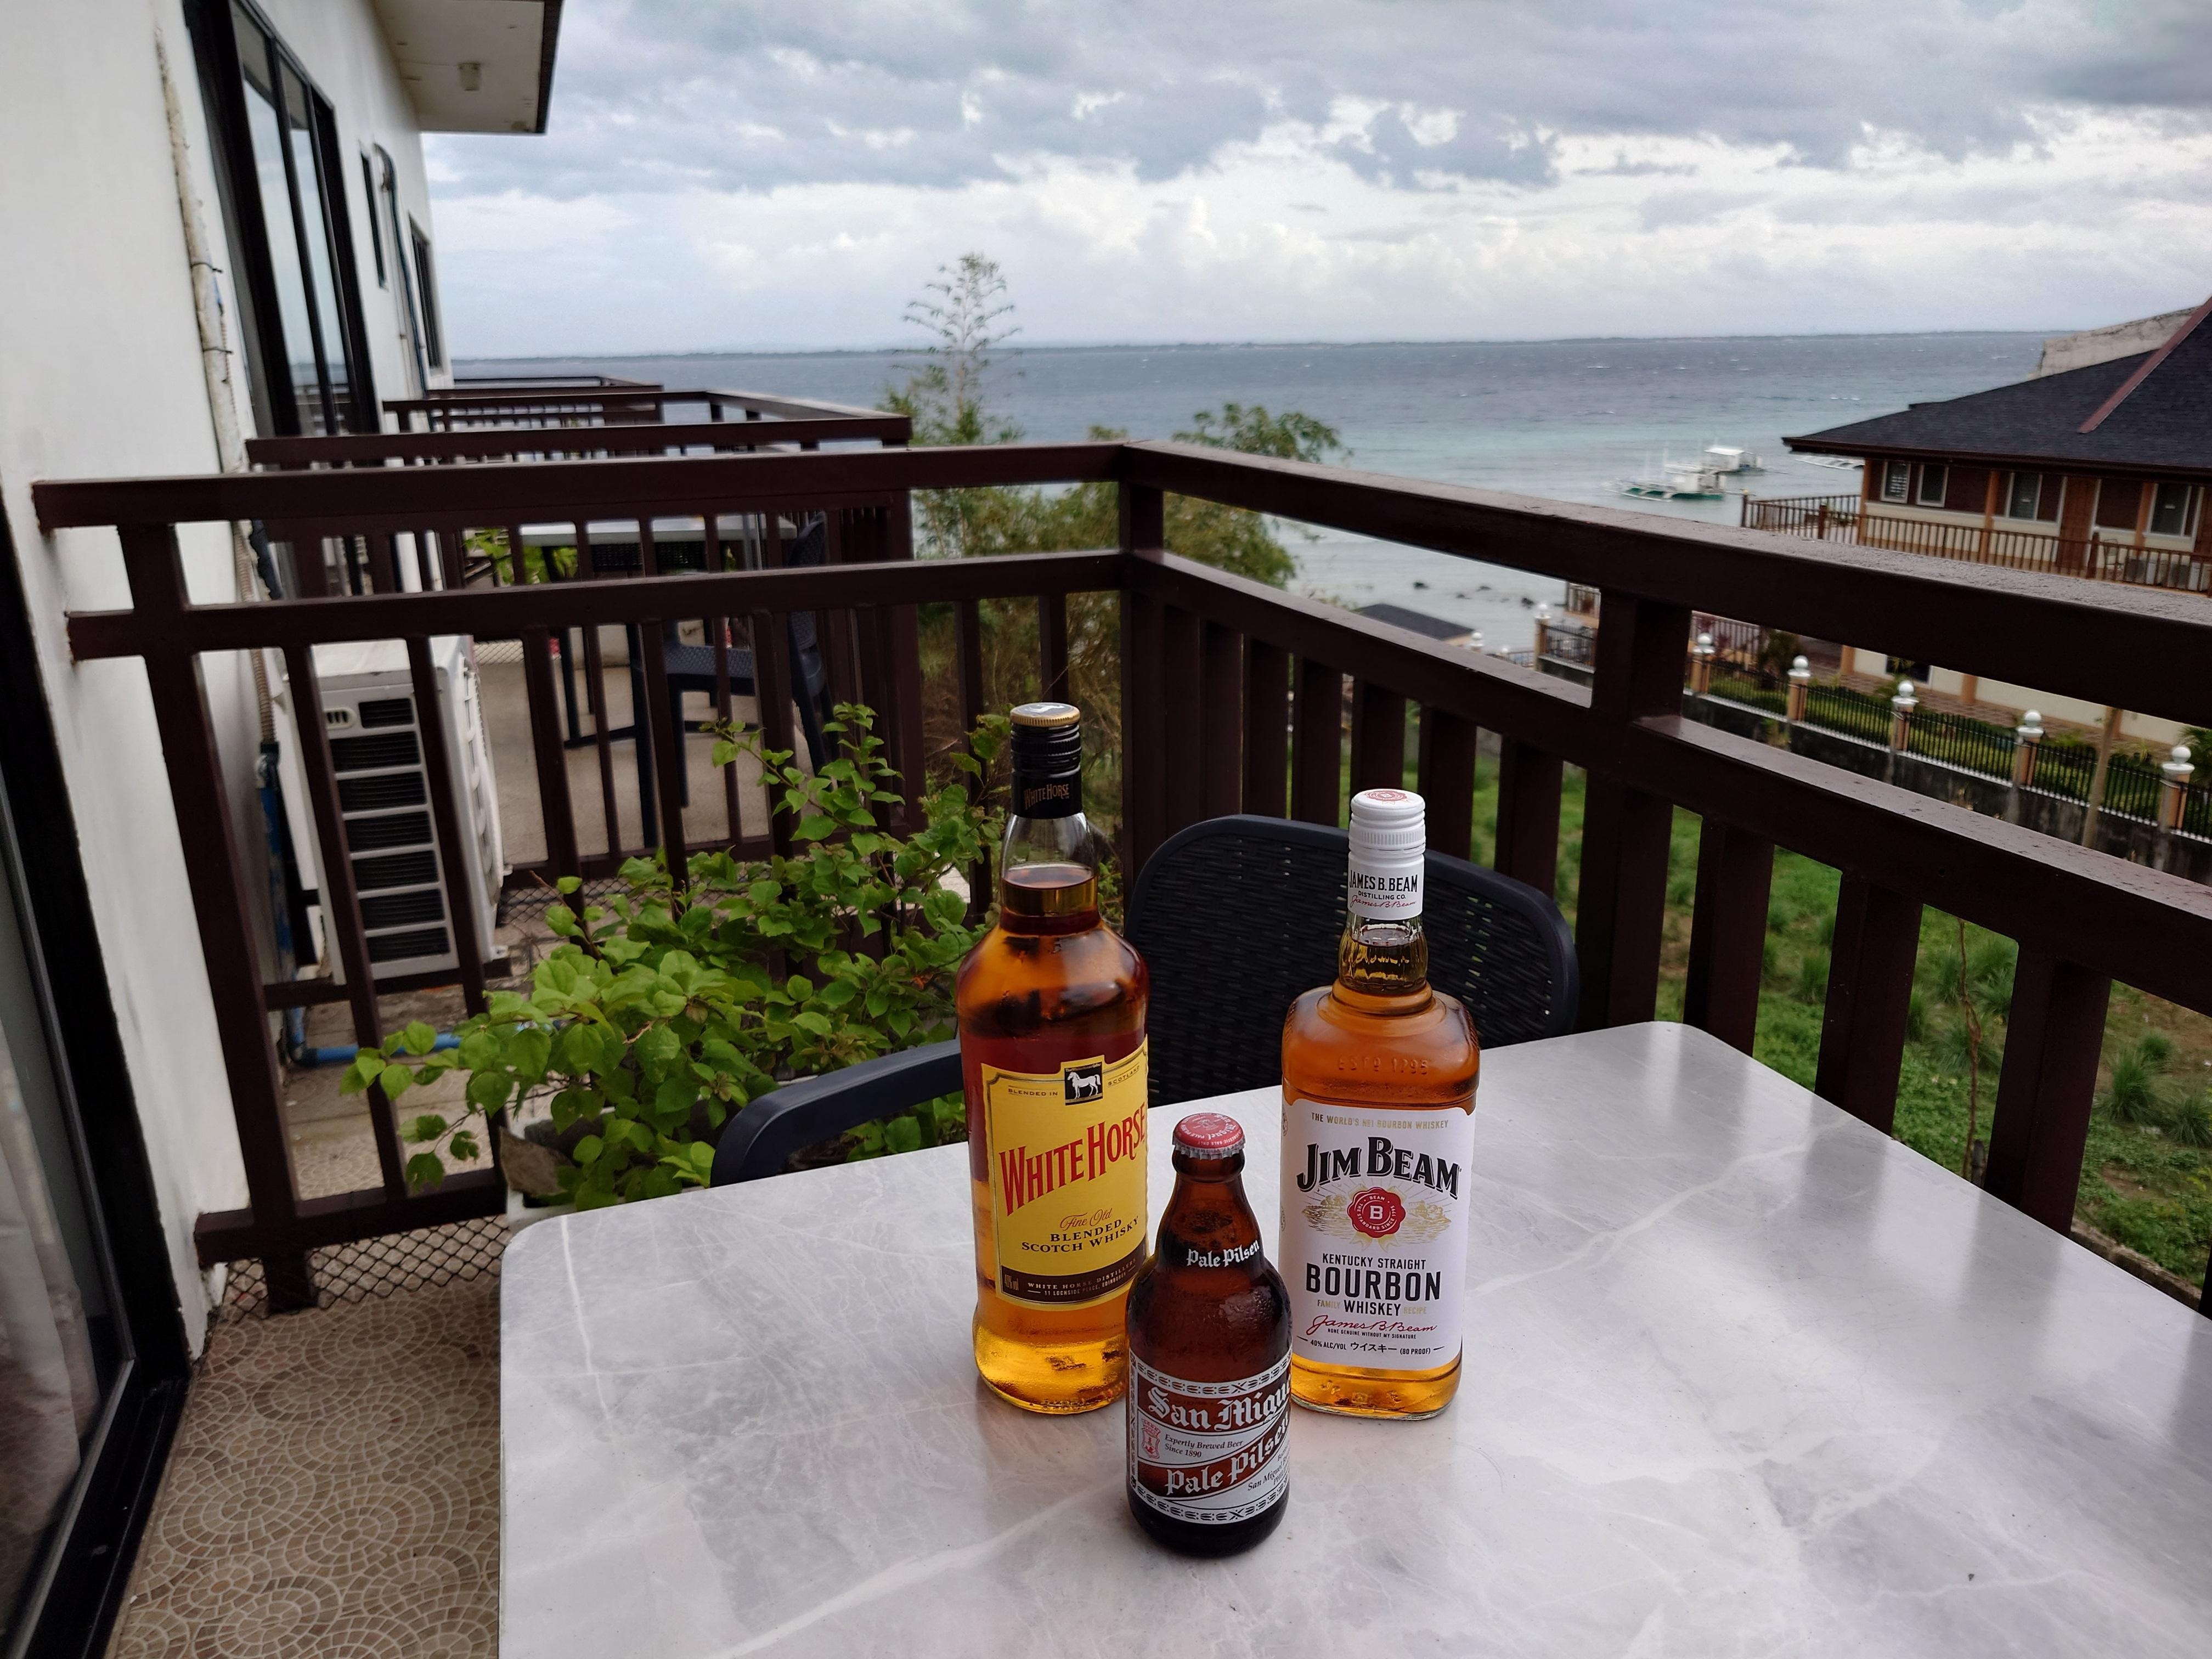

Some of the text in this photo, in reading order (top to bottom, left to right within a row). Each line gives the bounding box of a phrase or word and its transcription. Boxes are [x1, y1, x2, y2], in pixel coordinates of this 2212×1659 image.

[1024, 783, 1070, 810] WHITE HORSE
[1350, 870, 1376, 890] JAMES
[1389, 874, 1418, 893] BEAM
[1350, 895, 1380, 908] James
[1358, 890, 1395, 900] DISTILLING
[1108, 1065, 1140, 1086] SCOTLAND
[1311, 1112, 1324, 1122] THE
[1327, 1115, 1359, 1126] WORLD'S
[1377, 1120, 1413, 1129] BOURBON
[1415, 1120, 1448, 1129] WHISKEY
[998, 1102, 1145, 1216] WHITE HORSE
[1296, 1136, 1460, 1200] JIM BEAM
[1060, 1207, 1113, 1231] Fine Old
[1357, 1213, 1380, 1230] STANDARD
[1381, 1218, 1395, 1229] SINCE
[1370, 1205, 1383, 1220] B
[1022, 1216, 1138, 1252] SCOTCH WHISKY
[1051, 1219, 1122, 1242] BLENDED
[1186, 1240, 1260, 1267] Pale Pilsen
[1322, 1253, 1426, 1269] KENTUCKY STRAIGHT
[1306, 1262, 1441, 1301] BOURBON
[1317, 1299, 1427, 1316] FAMILY WHISKEY RECIPE
[1306, 1315, 1370, 1335] James
[1388, 1321, 1438, 1332] Beam
[1323, 1341, 1347, 1350] ALC/VOL
[1350, 1341, 1397, 1353] ウイスキー
[1147, 1386, 1211, 1429] San
[1165, 1434, 1244, 1449] Expertly Brewed Beer
[1165, 1443, 1202, 1458] Since 1890
[1164, 1465, 1224, 1496] Pale
[1248, 1482, 1262, 1491] San
